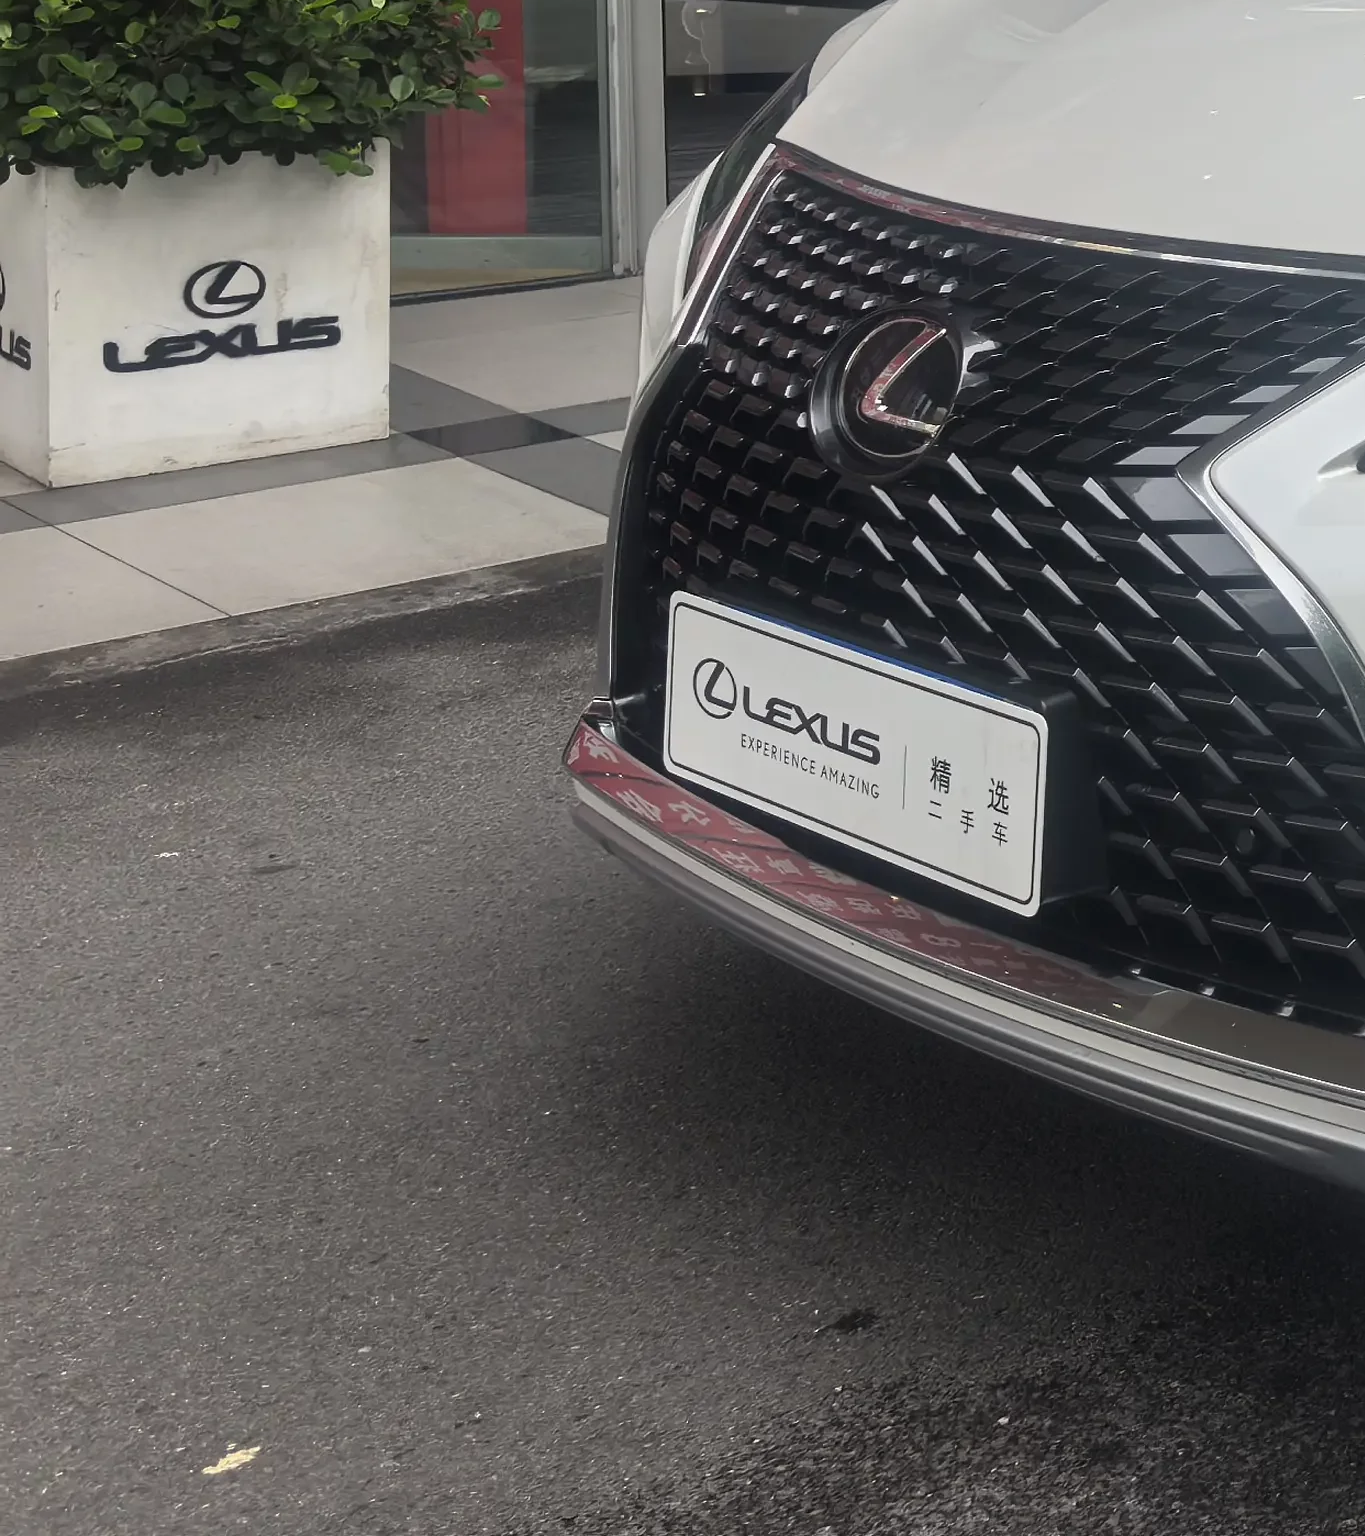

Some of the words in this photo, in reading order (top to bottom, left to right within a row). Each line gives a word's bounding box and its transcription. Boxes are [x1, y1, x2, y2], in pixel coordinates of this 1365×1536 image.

[103, 316, 341, 373] LEXUS
[743, 685, 881, 766] LEXUS
[741, 733, 816, 775] EXPERIENCE
[820, 768, 880, 799] AMAZING
